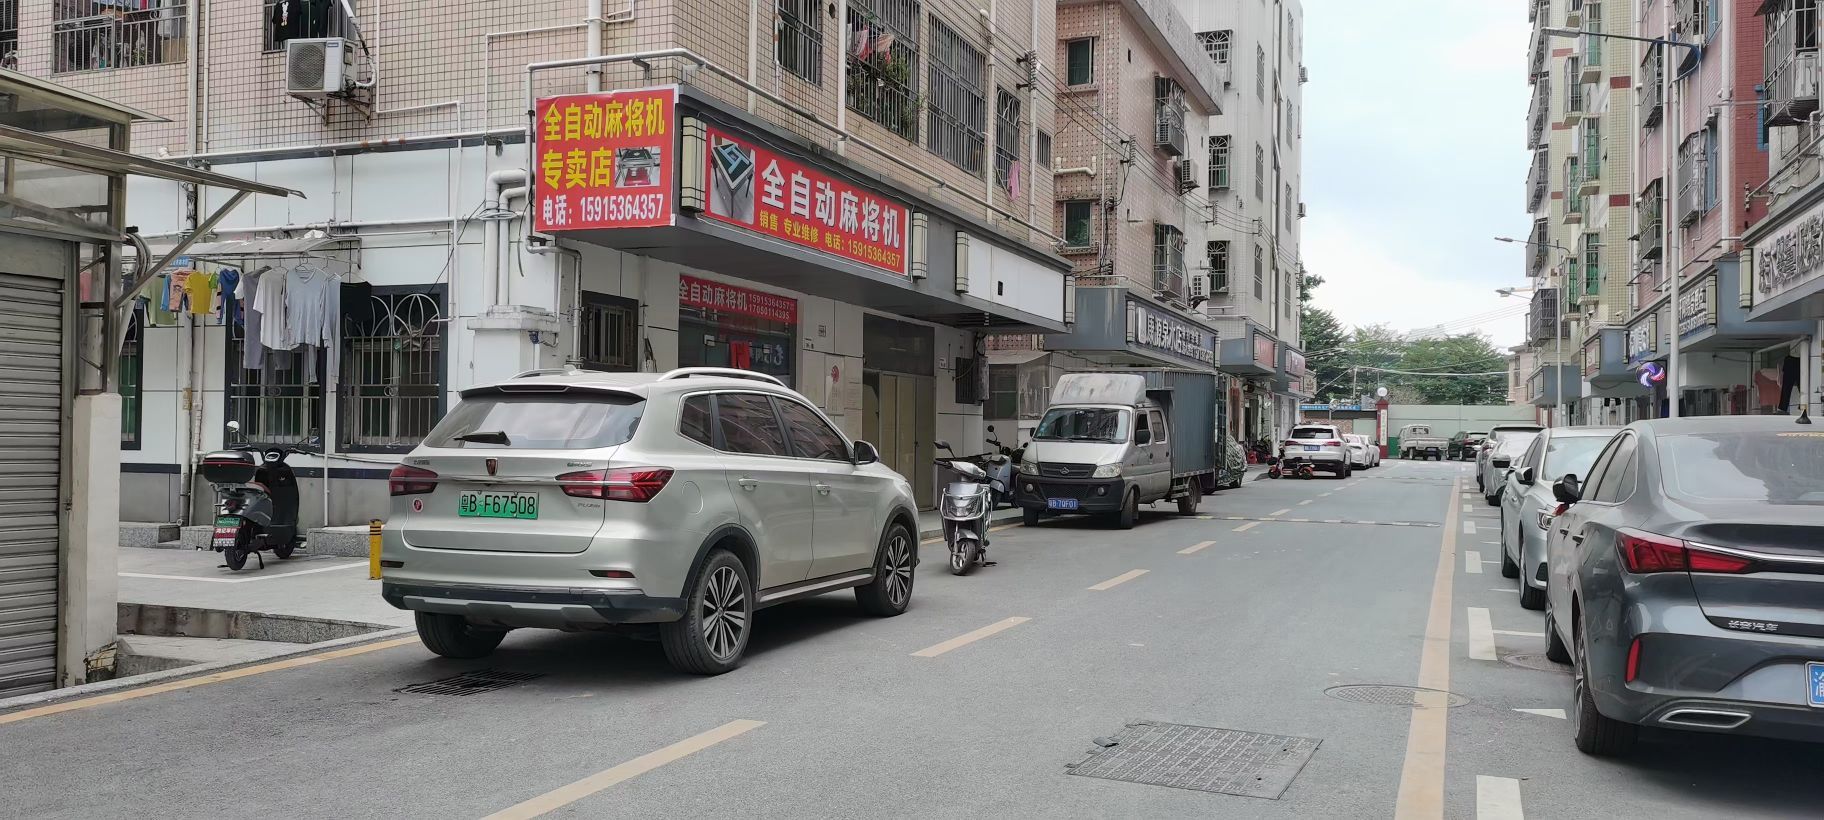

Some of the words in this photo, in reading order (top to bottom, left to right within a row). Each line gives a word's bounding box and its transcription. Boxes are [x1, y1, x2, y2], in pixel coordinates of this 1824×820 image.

[544, 97, 665, 141] 全自动麻将机
[542, 146, 612, 190] 专卖店
[580, 194, 664, 222] 15915364357
[761, 159, 900, 249] 全自动麻将机
[759, 210, 778, 232] 销售
[783, 217, 819, 244] 专业维修
[679, 279, 748, 312] 全自动麻将机
